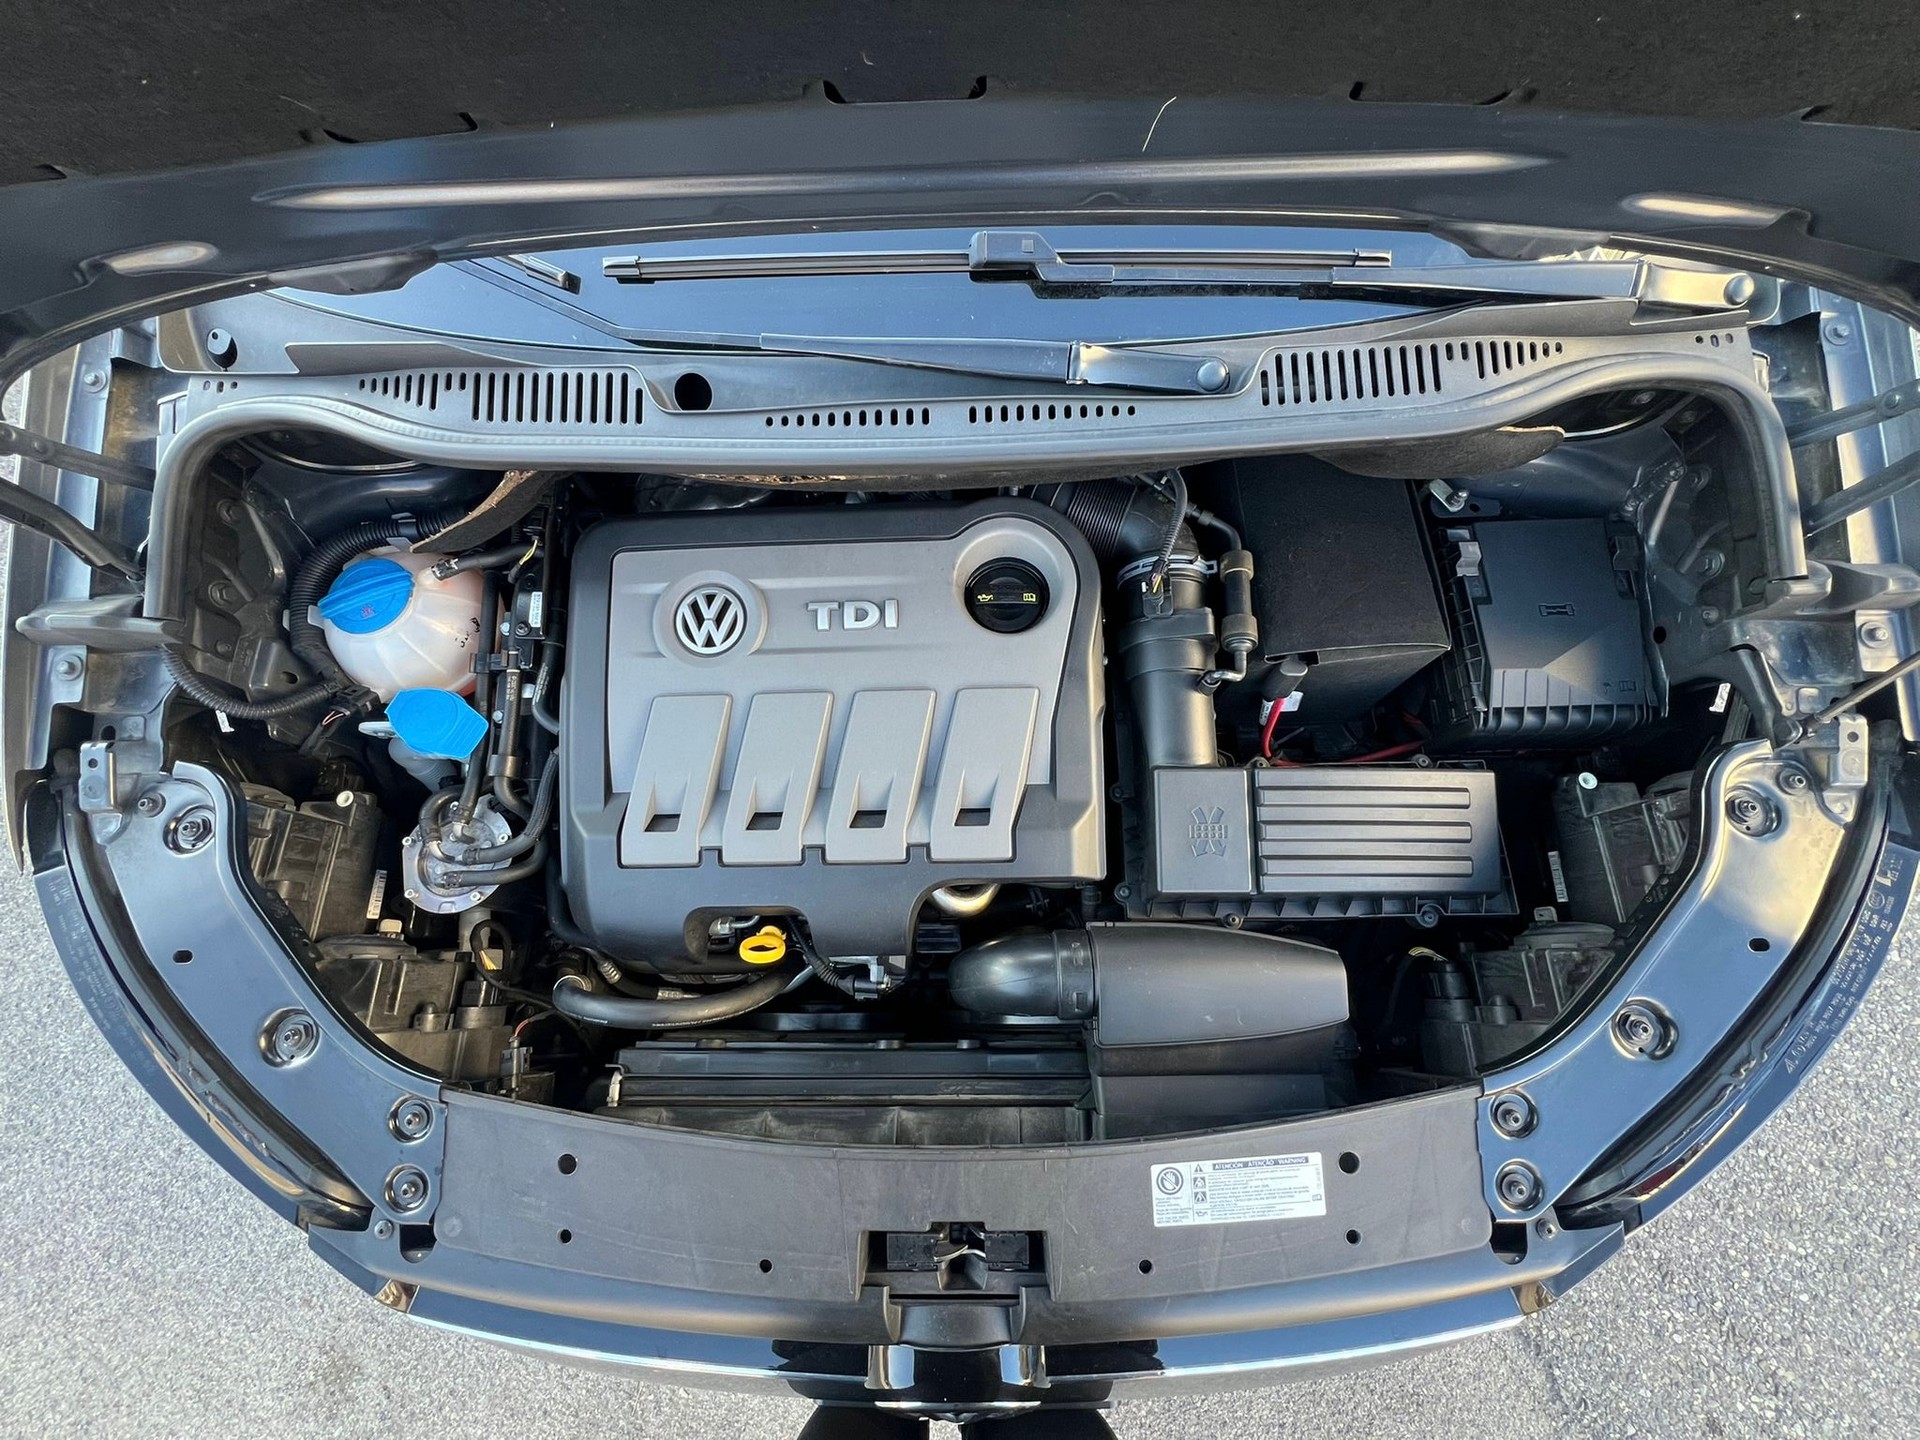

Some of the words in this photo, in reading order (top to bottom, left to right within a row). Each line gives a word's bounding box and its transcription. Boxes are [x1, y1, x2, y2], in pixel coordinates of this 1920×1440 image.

[676, 587, 745, 654] VW
[807, 599, 898, 631] TDI
[1215, 1162, 1243, 1170] ATENCIÓN
[1248, 1159, 1275, 1168] ATENÇÃO
[1278, 1157, 1306, 1165] WARNING
